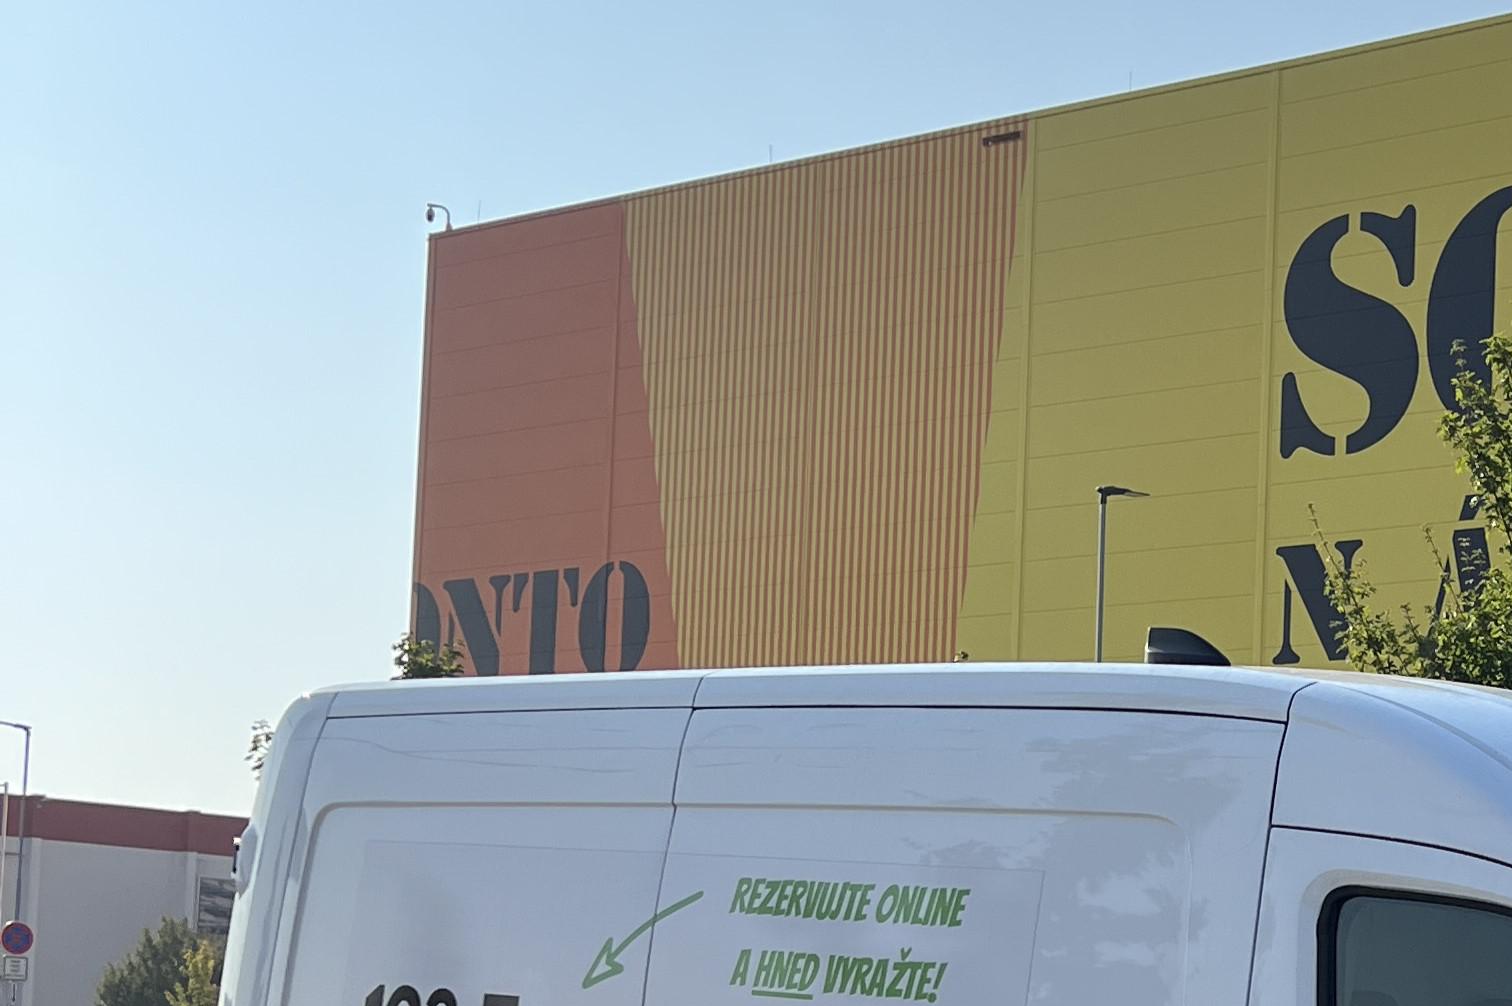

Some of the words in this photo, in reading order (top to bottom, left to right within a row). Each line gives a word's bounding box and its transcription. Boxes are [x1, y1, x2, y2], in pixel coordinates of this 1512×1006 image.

[729, 877, 876, 921] REZERVUJTE
[875, 884, 971, 928] ONLINE
[729, 949, 752, 986] A
[753, 950, 820, 994] HNED
[822, 947, 948, 1003] VYRAŽTE!
